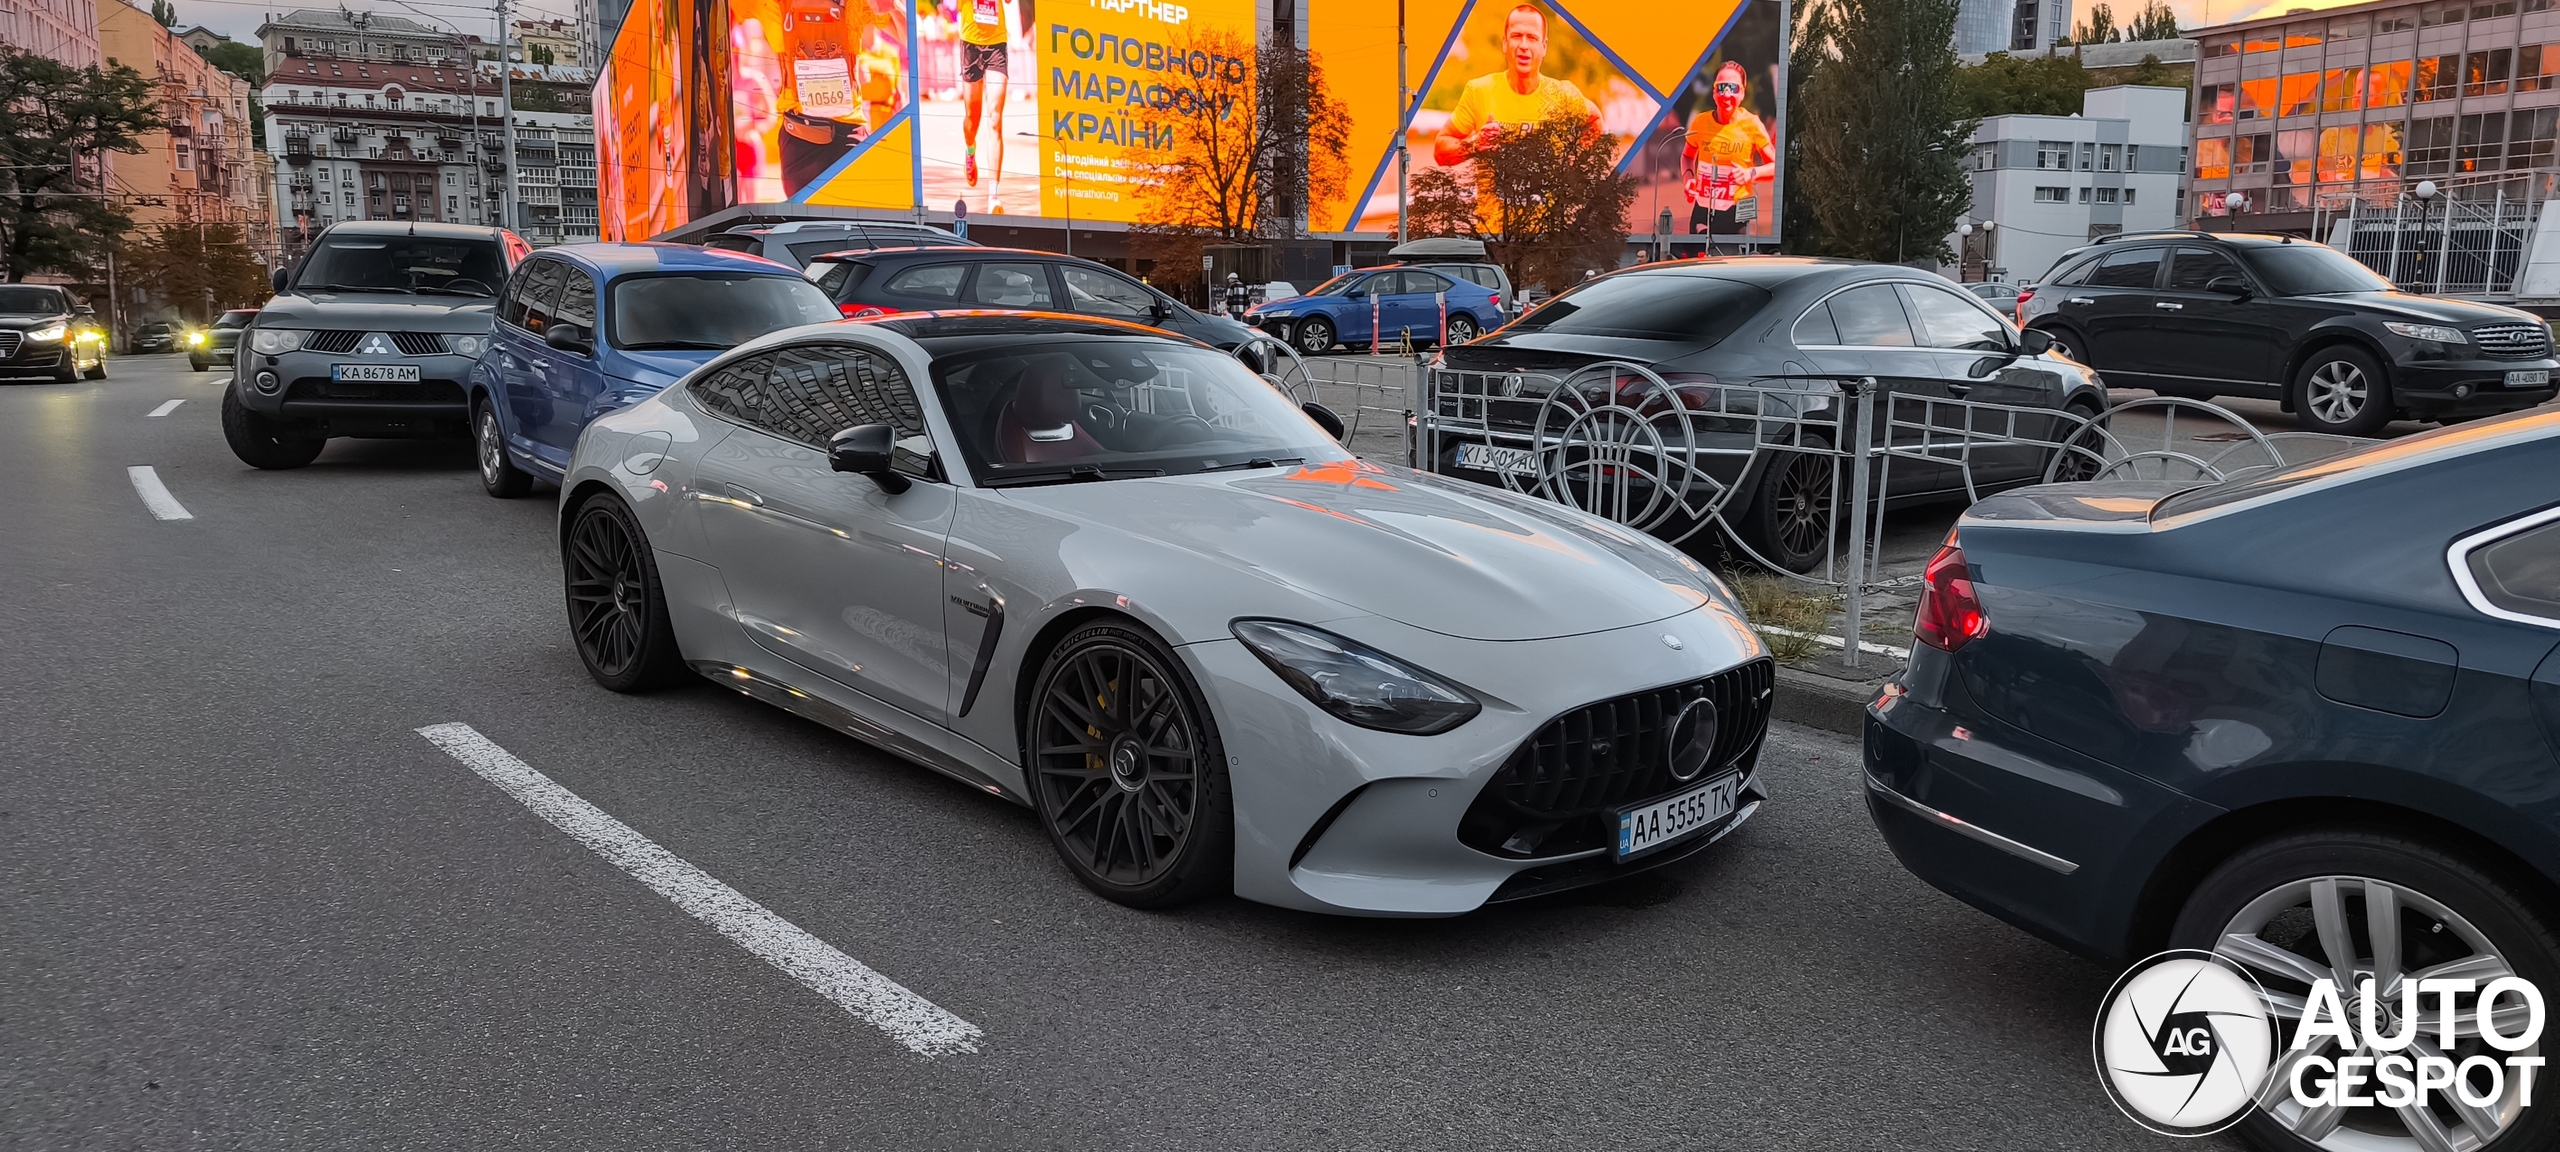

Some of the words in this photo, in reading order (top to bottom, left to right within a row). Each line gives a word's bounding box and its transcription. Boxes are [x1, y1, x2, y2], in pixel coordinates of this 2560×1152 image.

[1051, 23, 1245, 84] ГОЛОВНОГО
[808, 90, 844, 106] 10569
[1052, 67, 1236, 120] МАРАФОНУ
[1053, 108, 1173, 151] КРАЇНИ
[1720, 141, 1744, 153] RUN
[1054, 151, 1109, 167] Благодійний
[340, 367, 360, 379] KA
[363, 367, 394, 380] 8678
[397, 368, 416, 380] AM
[1462, 446, 1480, 463] KI
[1063, 628, 1109, 650] MICHELIN
[1633, 809, 1660, 847] AA
[1666, 791, 1706, 834] 5555
[1711, 780, 1733, 815] TK
[1620, 839, 1629, 849] UA
